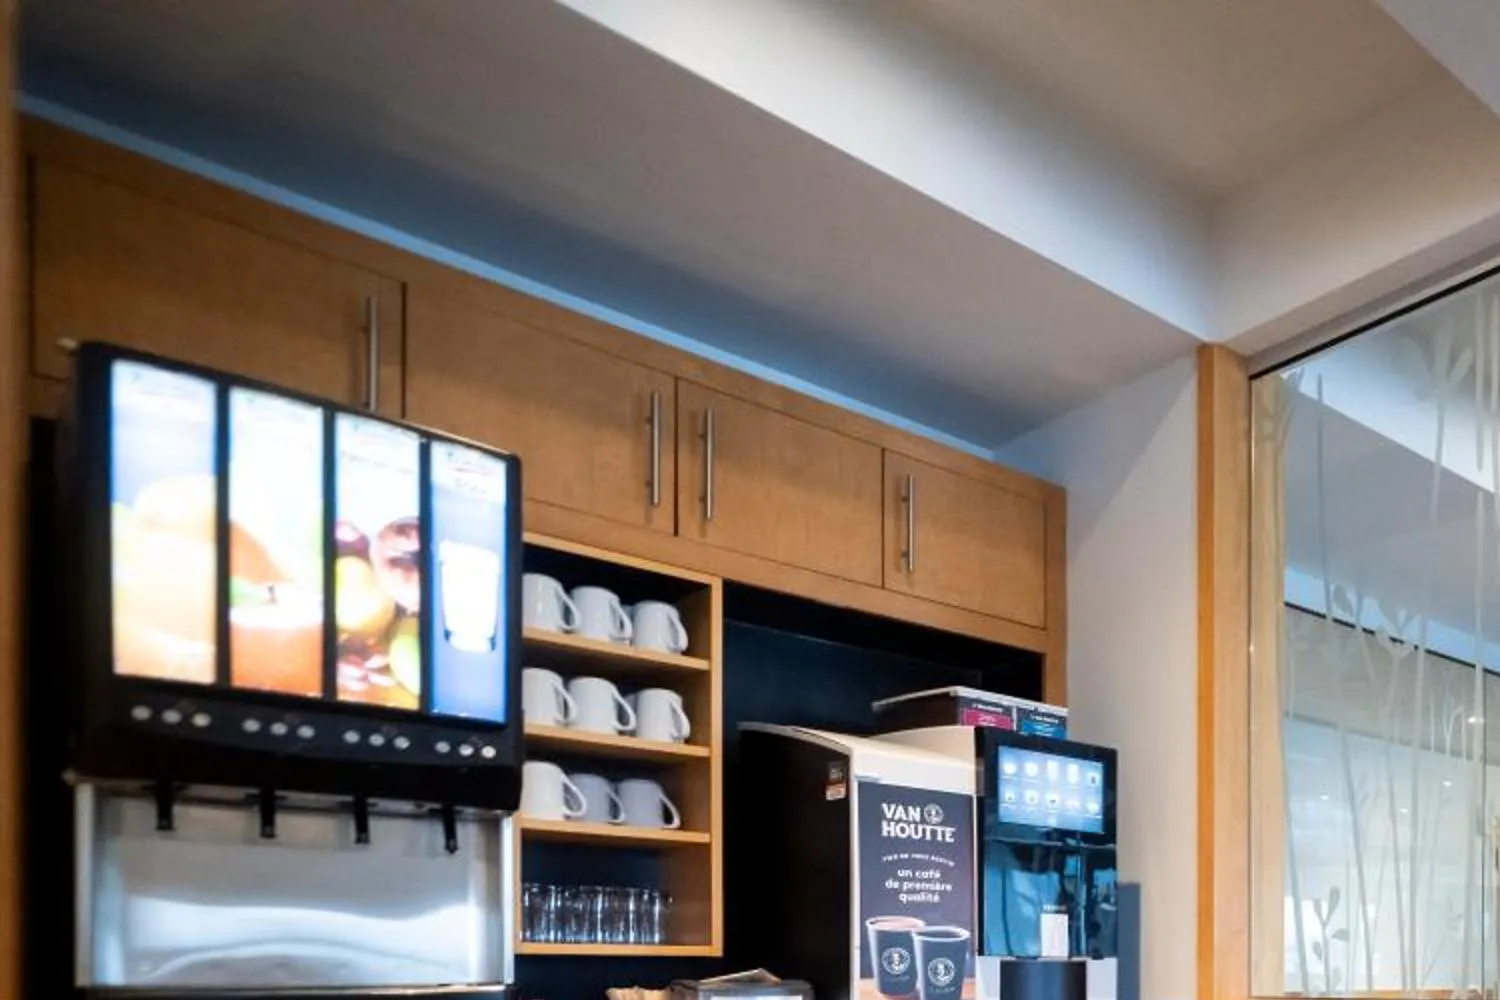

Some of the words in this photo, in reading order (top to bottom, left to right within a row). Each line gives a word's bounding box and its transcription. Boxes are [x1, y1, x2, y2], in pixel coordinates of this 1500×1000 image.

[881, 803, 921, 822] VAN
[881, 820, 956, 843] HOUTTE
[897, 869, 913, 877] un
[885, 878, 900, 889] de
